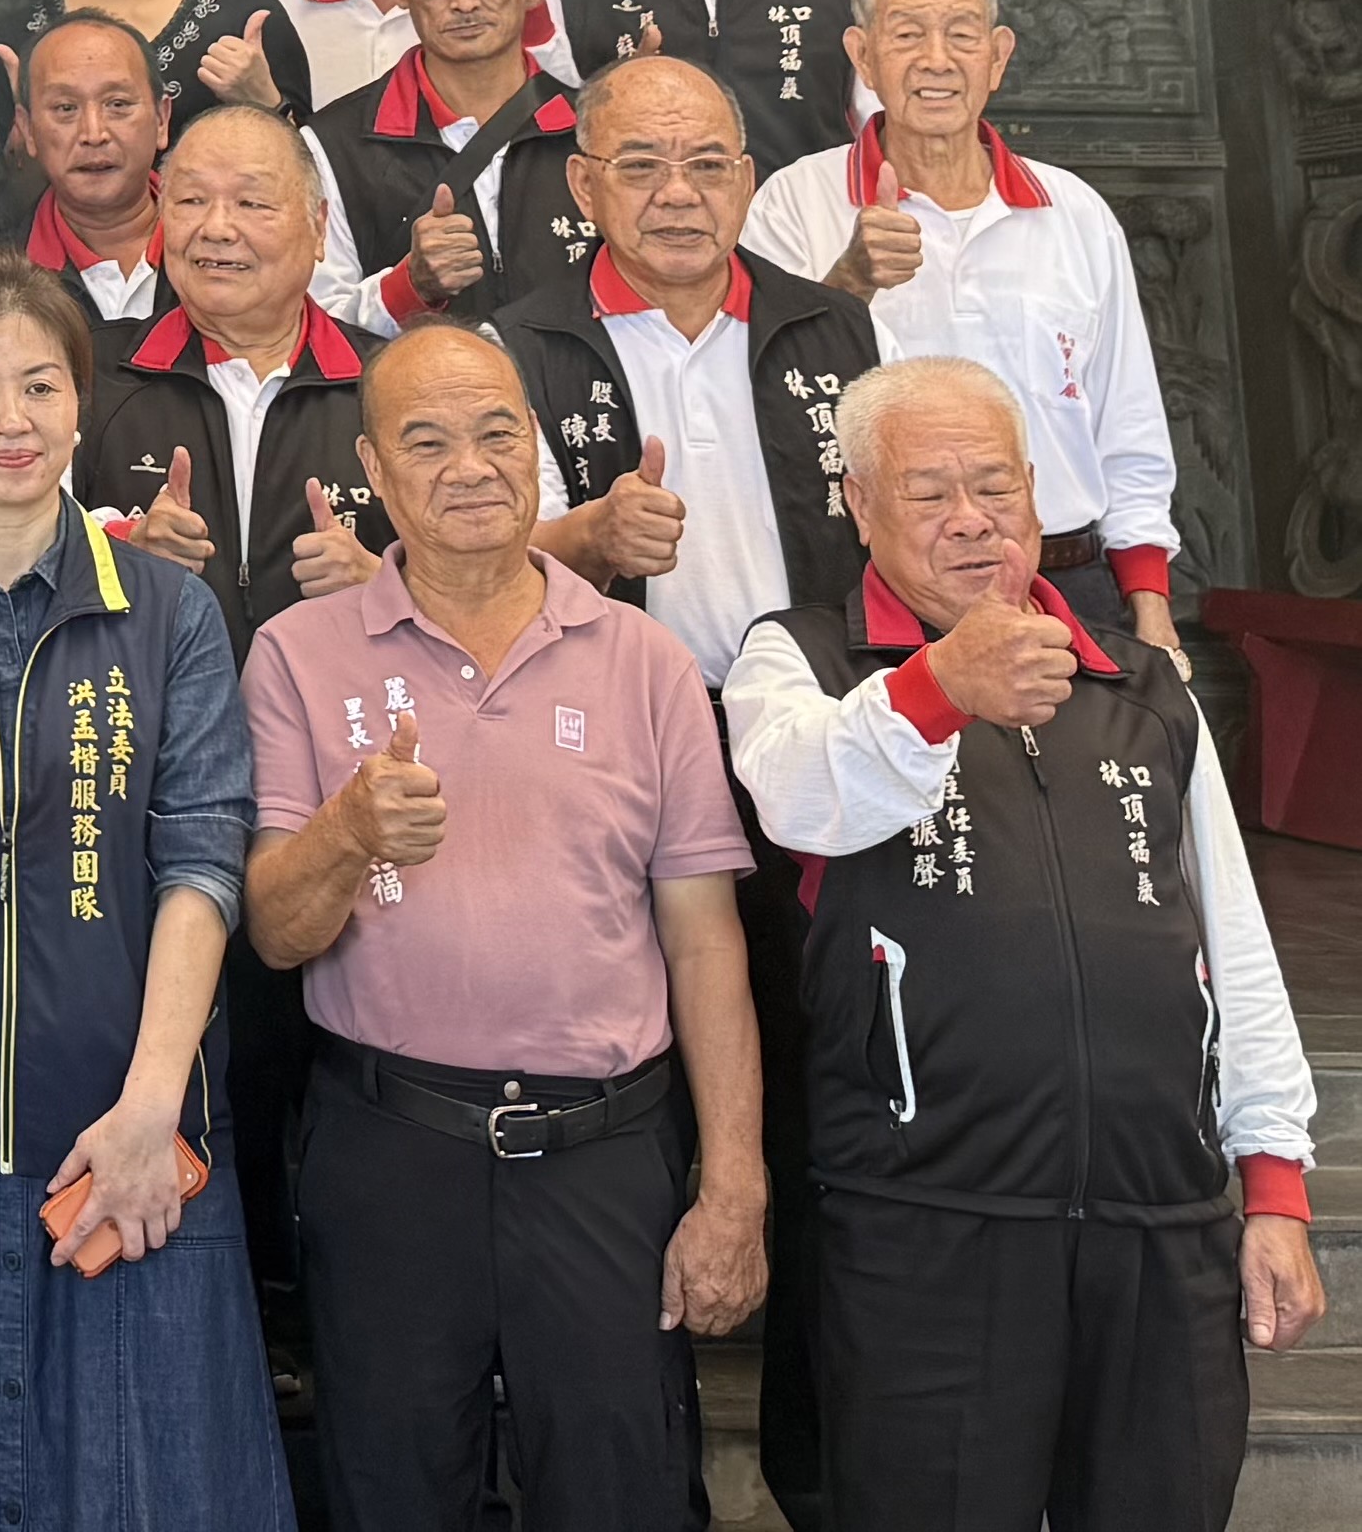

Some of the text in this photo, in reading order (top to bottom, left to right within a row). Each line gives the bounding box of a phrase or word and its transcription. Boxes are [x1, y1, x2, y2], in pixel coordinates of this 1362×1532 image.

[67, 678, 104, 922] 洪孟楷服務團隊
[104, 664, 135, 801] 立法委員
[943, 759, 976, 896] 主任委員
